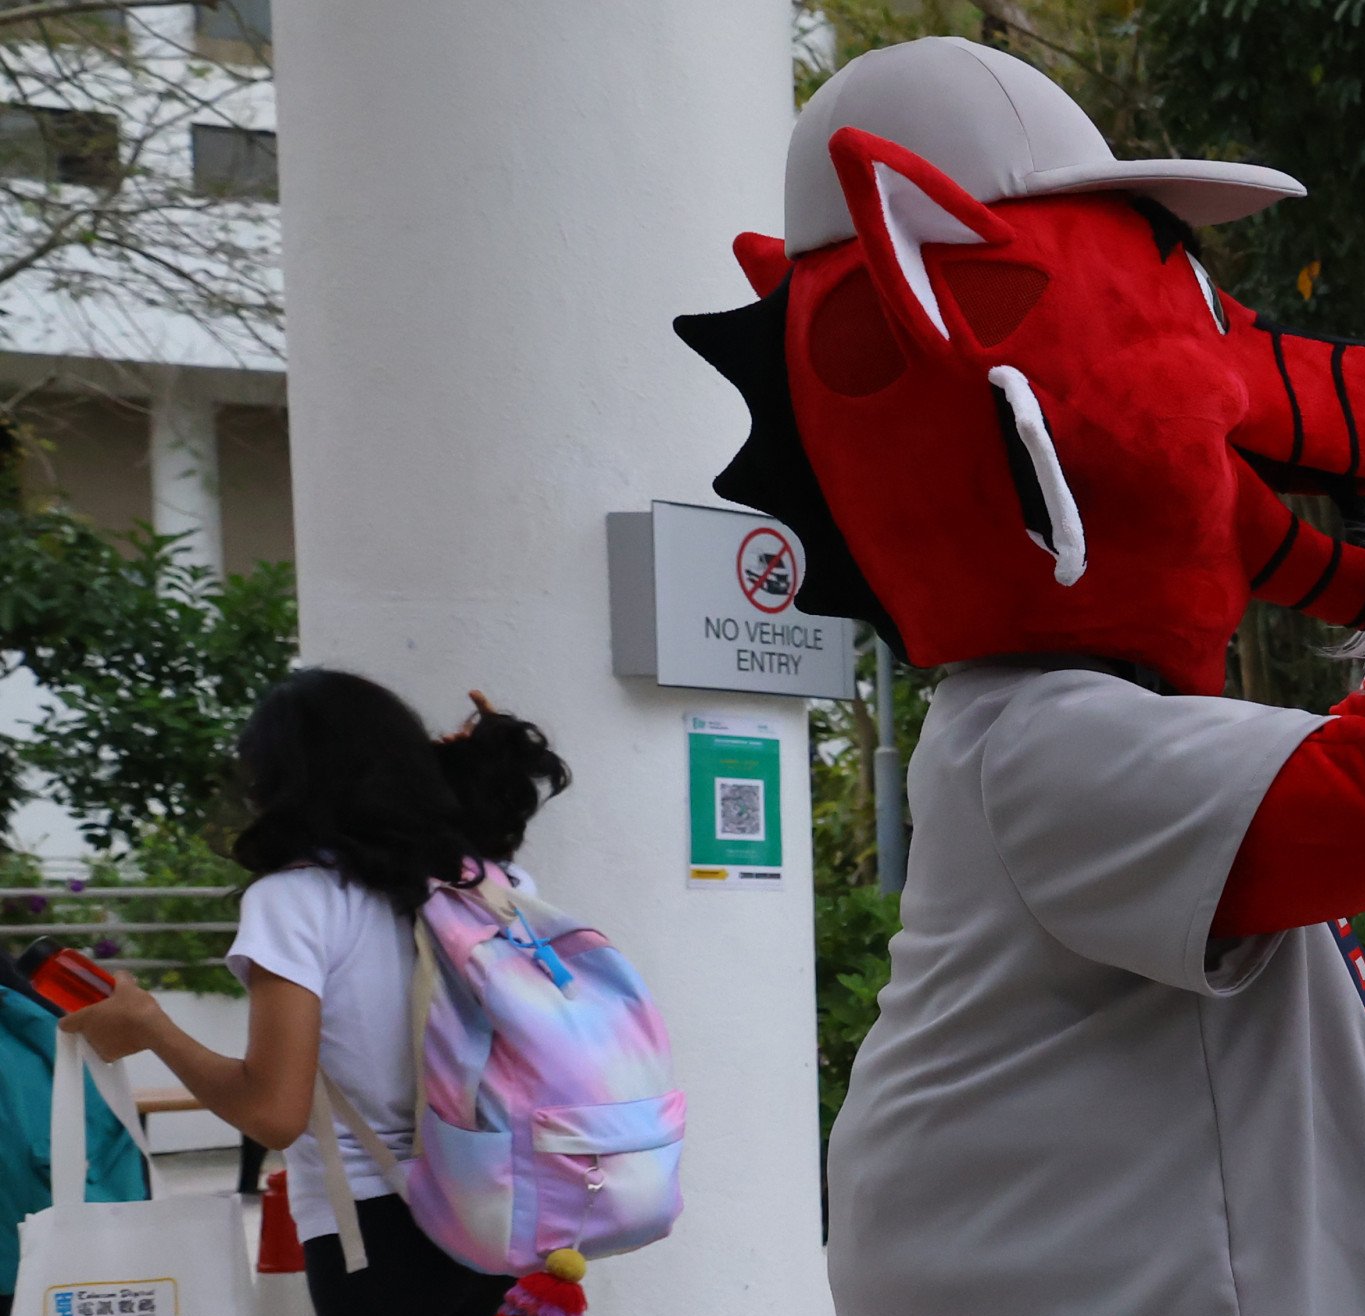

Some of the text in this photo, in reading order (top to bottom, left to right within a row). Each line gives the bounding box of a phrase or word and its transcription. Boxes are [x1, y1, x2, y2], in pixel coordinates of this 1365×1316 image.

[705, 616, 823, 650] NO VEHICLE
[737, 649, 802, 675] ENTRY
